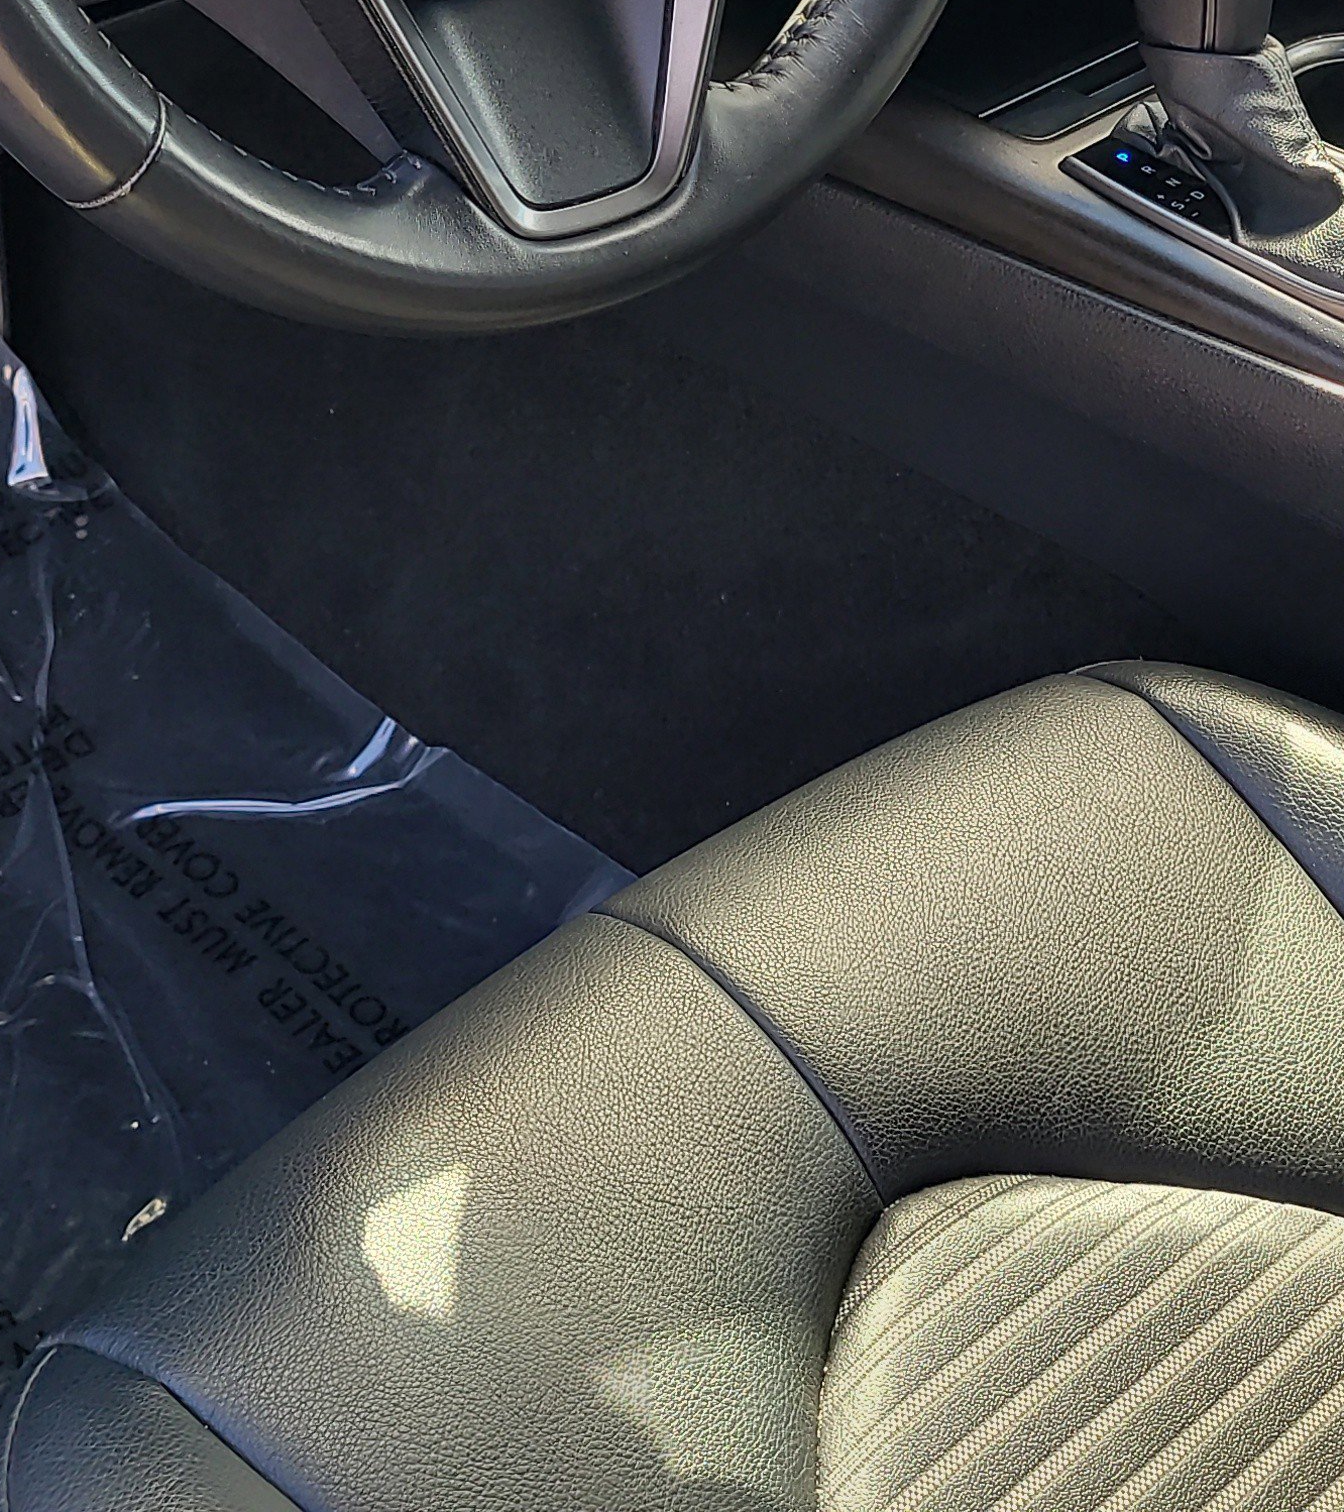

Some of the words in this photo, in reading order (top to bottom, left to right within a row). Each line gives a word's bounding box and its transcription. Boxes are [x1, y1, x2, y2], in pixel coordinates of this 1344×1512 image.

[1141, 165, 1156, 175] R
[1165, 177, 1182, 189] N
[1190, 190, 1205, 201] D
[1171, 200, 1186, 211] S
[155, 891, 257, 978] MUST
[233, 894, 410, 1046] ROTECTIVE
[254, 974, 369, 1080] EALER
